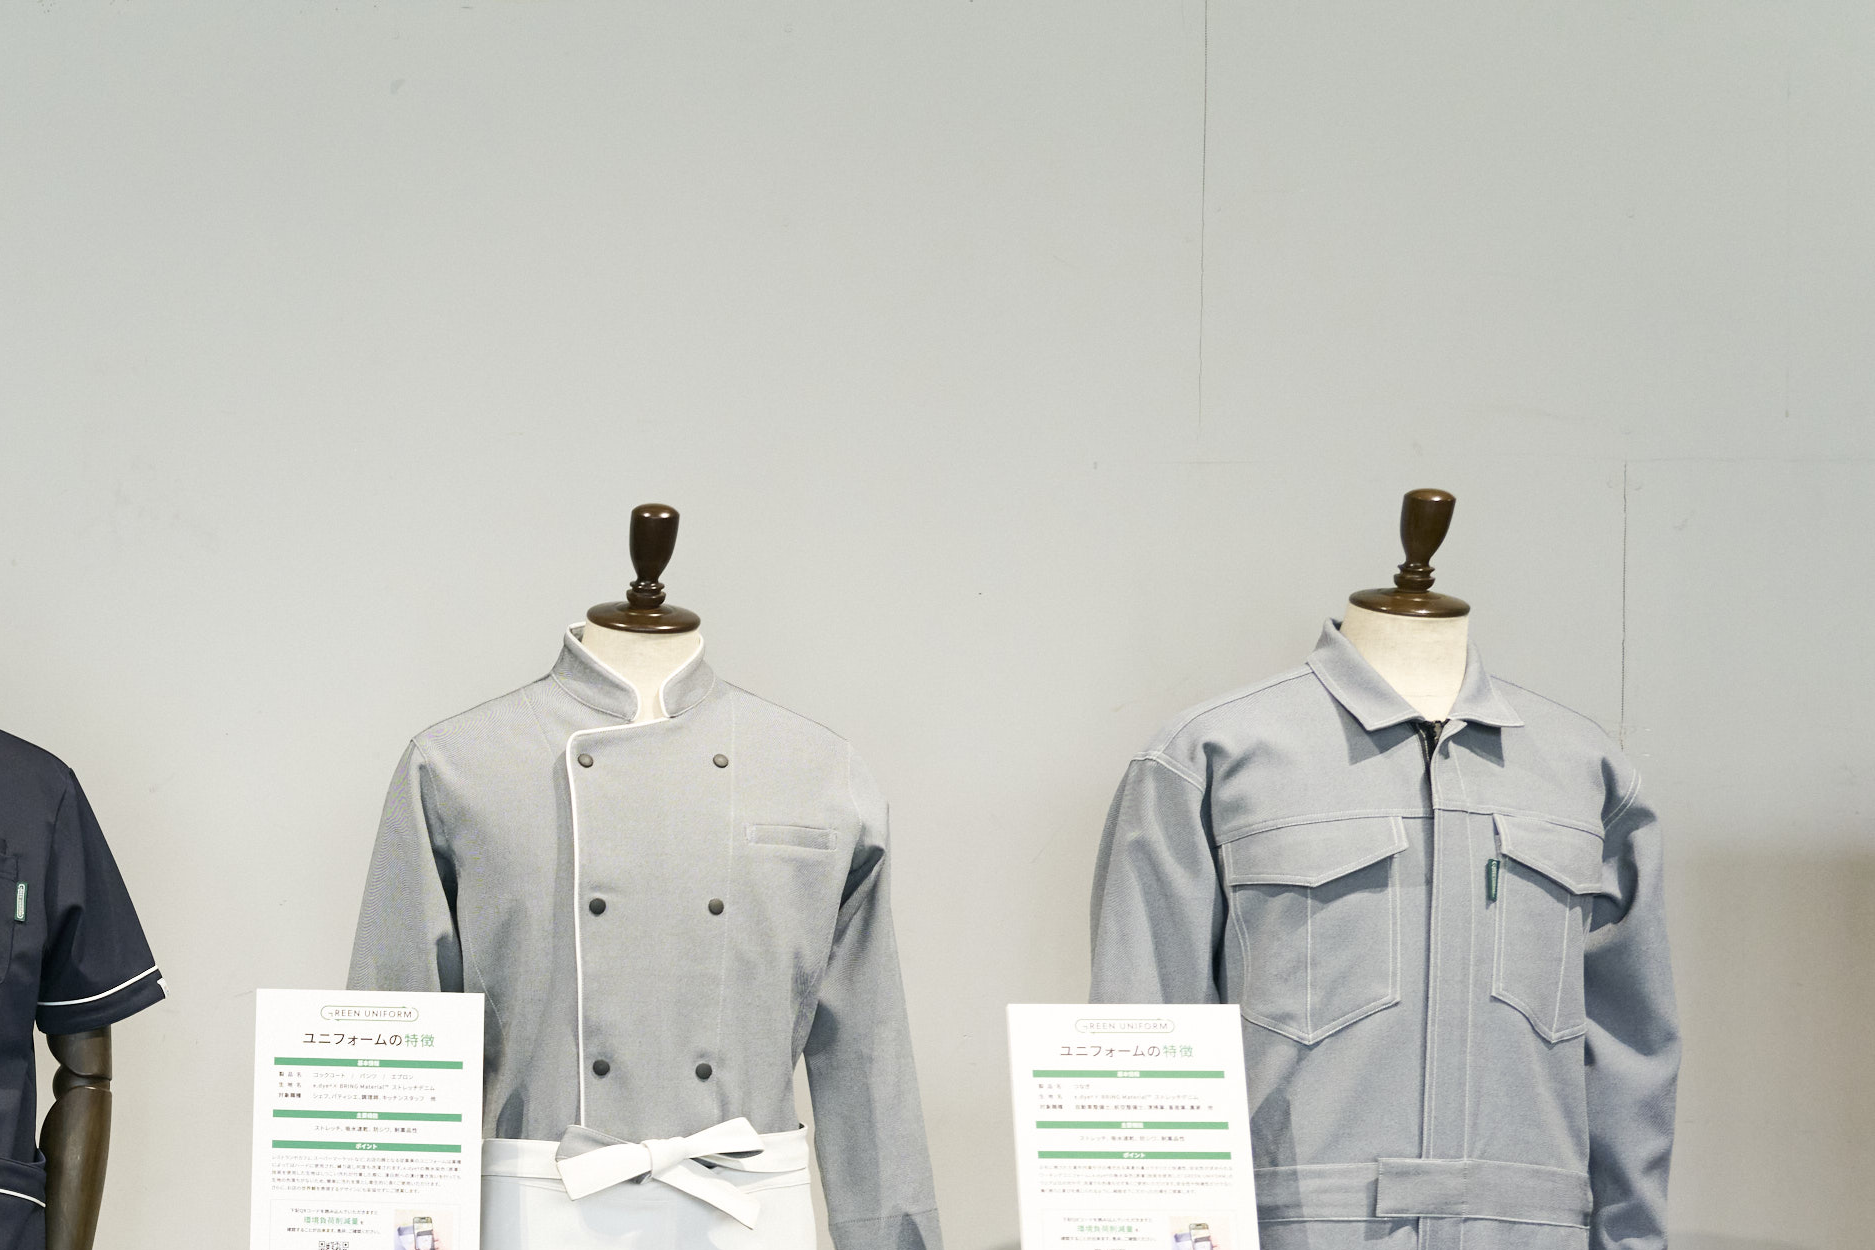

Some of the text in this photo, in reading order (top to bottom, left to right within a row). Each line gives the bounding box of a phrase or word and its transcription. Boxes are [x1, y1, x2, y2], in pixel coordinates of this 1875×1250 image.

[364, 1010, 412, 1018] UNIFORM
[1119, 1022, 1168, 1030] UNIFORM
[302, 1033, 435, 1048] ユニフォームの特徴
[1060, 1044, 1194, 1058] ユニフォームの特徴
